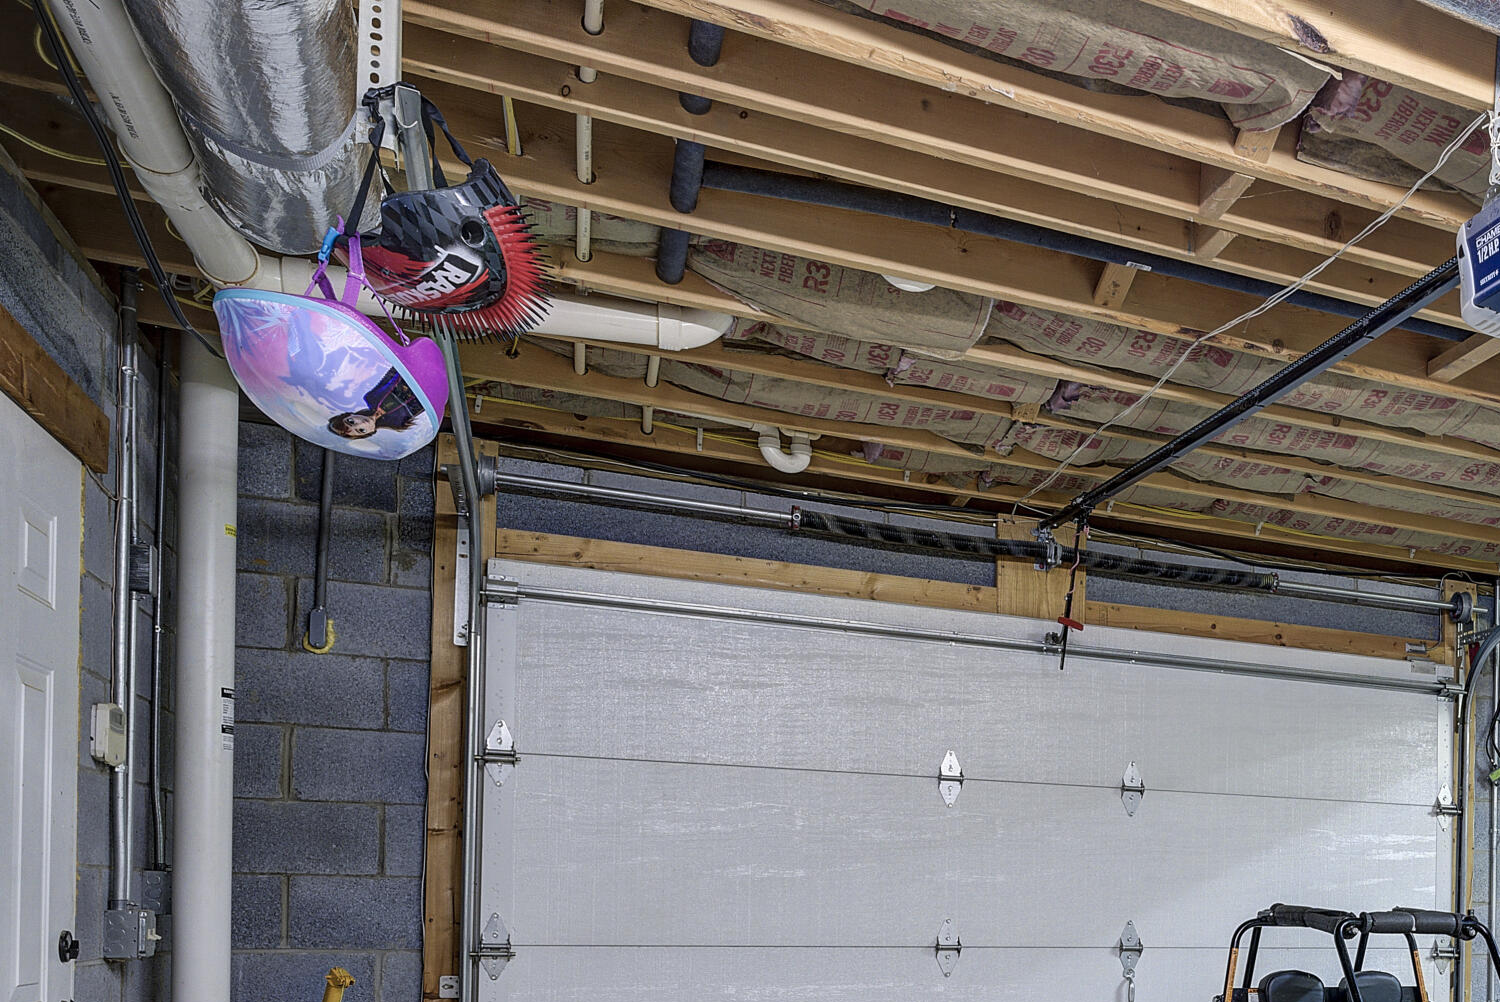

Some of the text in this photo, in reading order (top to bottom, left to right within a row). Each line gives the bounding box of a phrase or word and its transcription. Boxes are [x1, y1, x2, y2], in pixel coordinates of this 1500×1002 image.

[1424, 113, 1462, 147] PINK
[759, 251, 776, 278] NEXT
[1477, 244, 1488, 263] 1/2
[802, 260, 831, 294] R3
